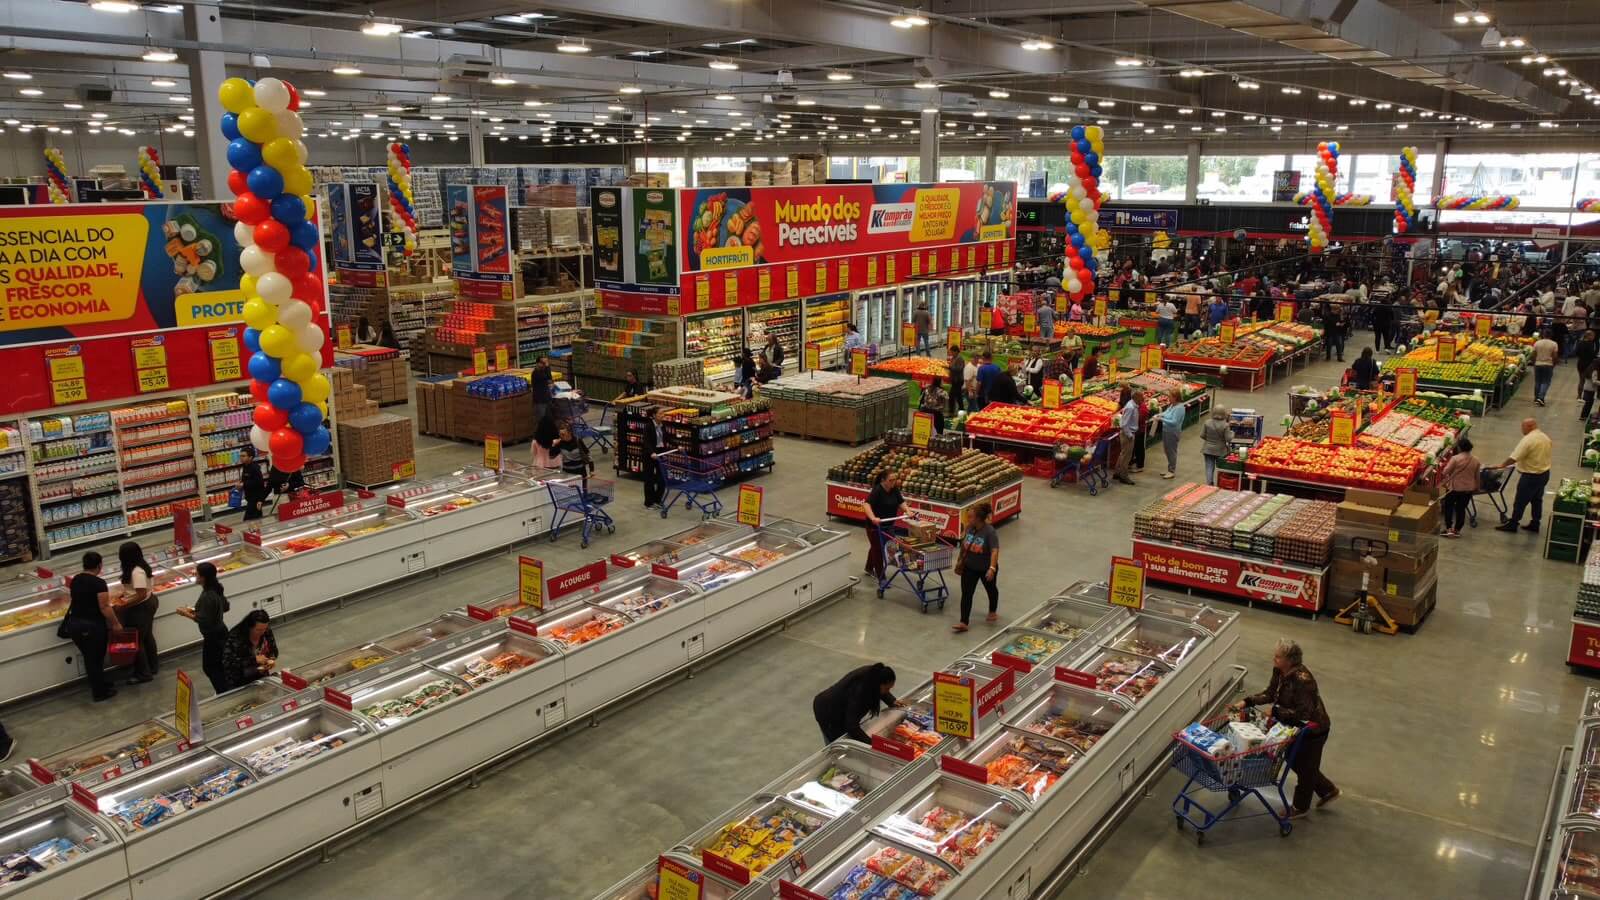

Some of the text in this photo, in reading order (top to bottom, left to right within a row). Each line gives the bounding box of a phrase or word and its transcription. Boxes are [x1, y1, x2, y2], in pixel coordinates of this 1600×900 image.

[775, 194, 860, 224] Mundo dos
[1131, 215, 1152, 223] Nani
[87, 227, 114, 242] DO
[779, 219, 857, 247] Perecíveis
[14, 249, 27, 265] A
[30, 248, 61, 264] DIA
[63, 245, 107, 262] COM
[705, 250, 749, 266] HORTIFRÚTI
[15, 261, 124, 286] QUALIDADE,
[5, 282, 93, 302] FRESCOR
[8, 298, 111, 321] ECONOMIA
[292, 501, 331, 517] CONGELADOS
[299, 497, 323, 508] PRATOS
[1142, 552, 1229, 576] Tudo de bom para
[1150, 563, 1228, 585] sua alimentação
[560, 571, 591, 590] AÇOUGUE
